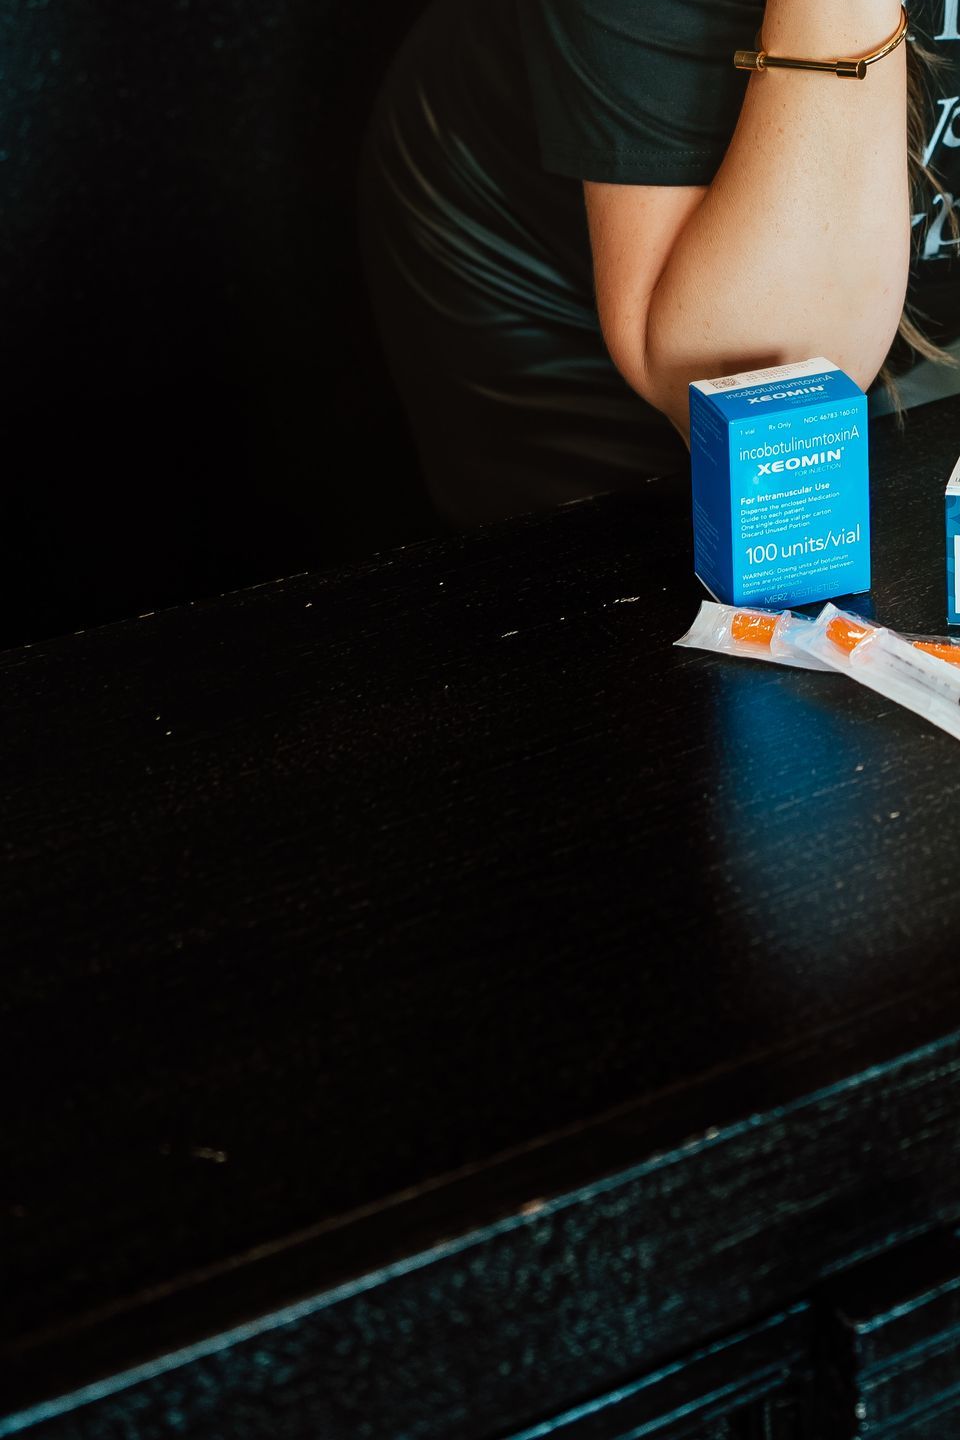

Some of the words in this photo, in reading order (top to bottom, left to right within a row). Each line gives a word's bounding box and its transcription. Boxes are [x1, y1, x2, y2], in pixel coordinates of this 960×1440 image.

[725, 374, 834, 400] incobotulinumtoxinA
[747, 385, 824, 405] XEOMIN
[777, 421, 792, 430] Only
[803, 416, 818, 424] NDC
[739, 424, 860, 461] incobotulinumtoxinA
[757, 447, 842, 477] XEOMIN
[794, 467, 807, 477] FOR
[808, 462, 842, 475] INJECTION
[740, 496, 755, 506] For
[757, 485, 813, 503] Intramuscular
[814, 482, 830, 491] Use
[740, 505, 768, 517] Dispense
[769, 502, 780, 510] the
[780, 497, 807, 508] enclosed
[807, 491, 840, 503] Medication
[740, 515, 759, 524] Guide
[768, 510, 783, 519] each
[783, 506, 805, 517] patient
[740, 523, 755, 531] One
[790, 514, 801, 522] vial
[812, 508, 832, 517] carton
[741, 528, 764, 539] Discard
[765, 524, 788, 534] Unused
[745, 543, 778, 565] 100
[781, 523, 860, 559] units/vial
[764, 592, 788, 604] MERZ
[790, 581, 840, 598] AESTHETICS
